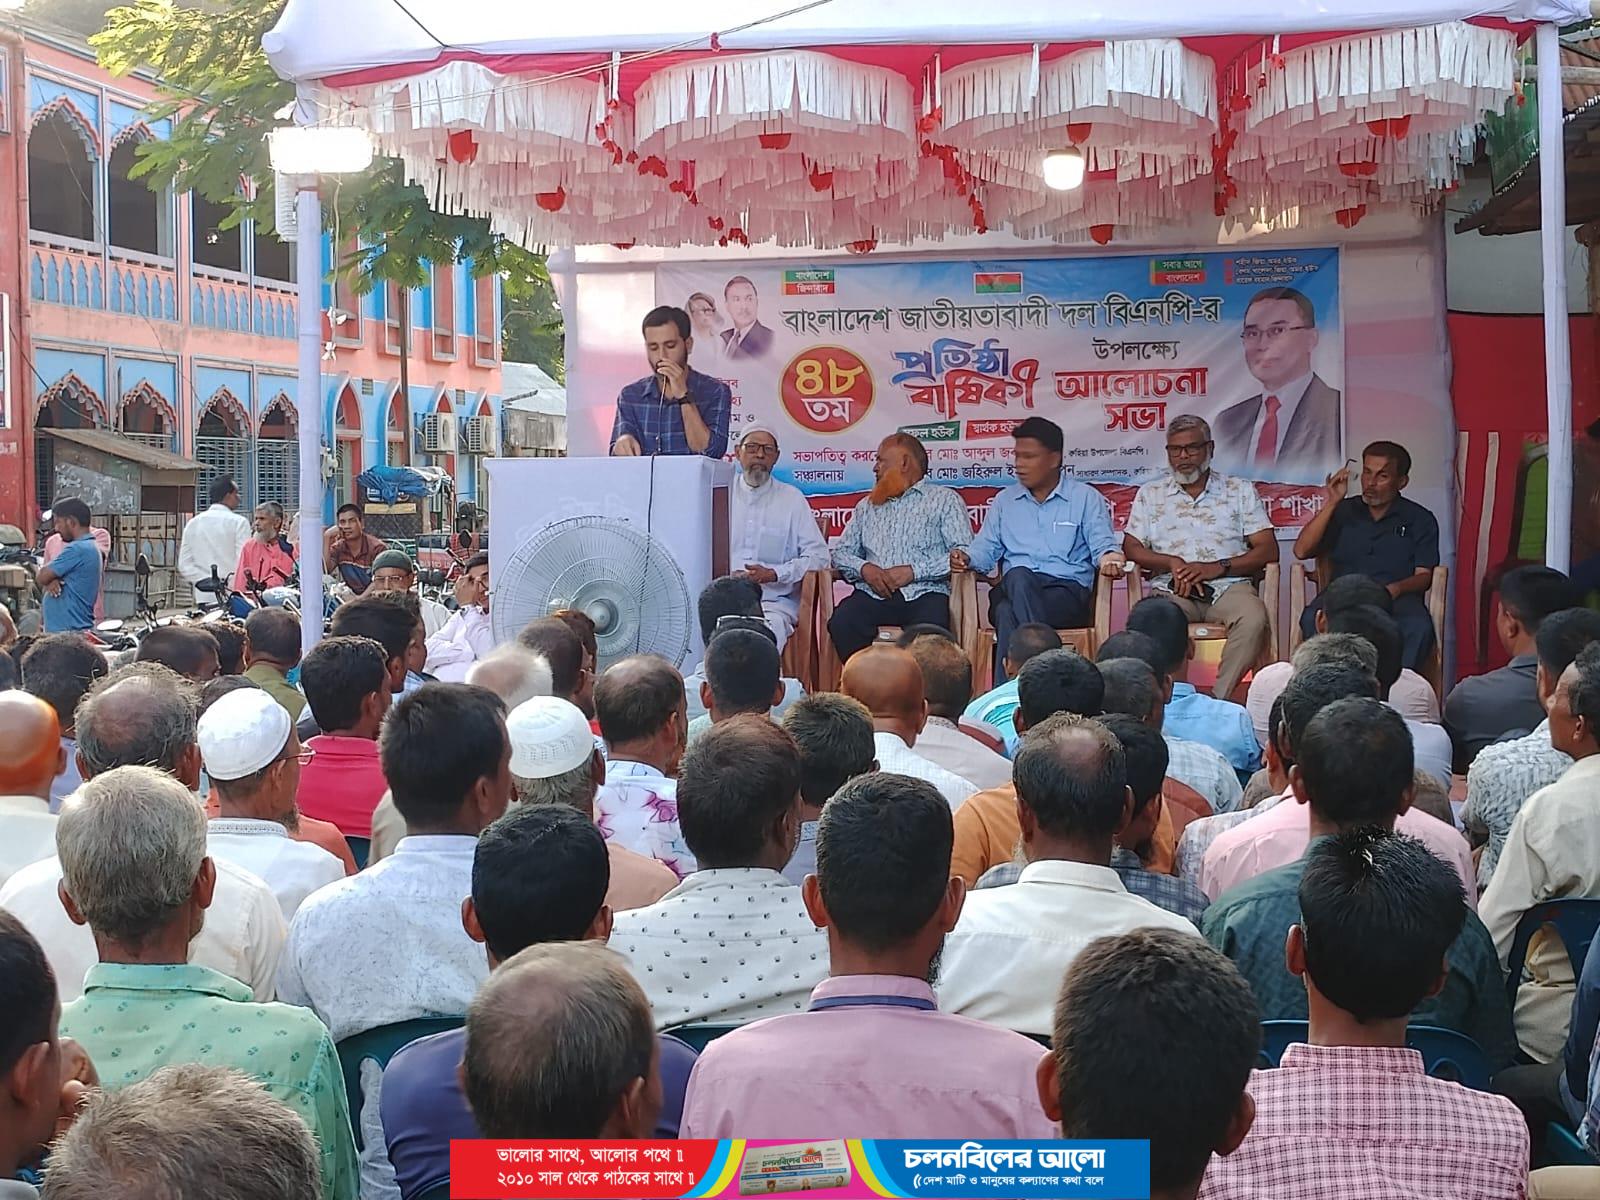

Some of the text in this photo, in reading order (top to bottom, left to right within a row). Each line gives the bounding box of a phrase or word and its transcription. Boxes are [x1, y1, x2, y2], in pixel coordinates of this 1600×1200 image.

[1163, 260, 1182, 270] সবার
[1165, 272, 1200, 283] বাংলাদেশ
[782, 291, 1224, 334] বাংলাদেশ জাতীয়তাবাদী দল বিএনপি-র
[1092, 337, 1180, 360] উপলক্ষ্যে
[891, 337, 1009, 384] প্রতিষ্ঠা
[795, 358, 864, 396] ৪৮
[1053, 367, 1209, 400] আলোচনা
[801, 397, 854, 424] তম
[1104, 401, 1167, 432] সভা
[931, 425, 955, 438] হউক
[793, 447, 847, 466] সভাপতিত্ব
[937, 448, 959, 461] মোঃ
[962, 447, 995, 462] আব্দুল
[794, 469, 844, 482] সঞ্চালনায়
[937, 467, 958, 480] মোঃ
[962, 463, 1002, 480] জহিরুল
[1279, 494, 1324, 517] শাখা
